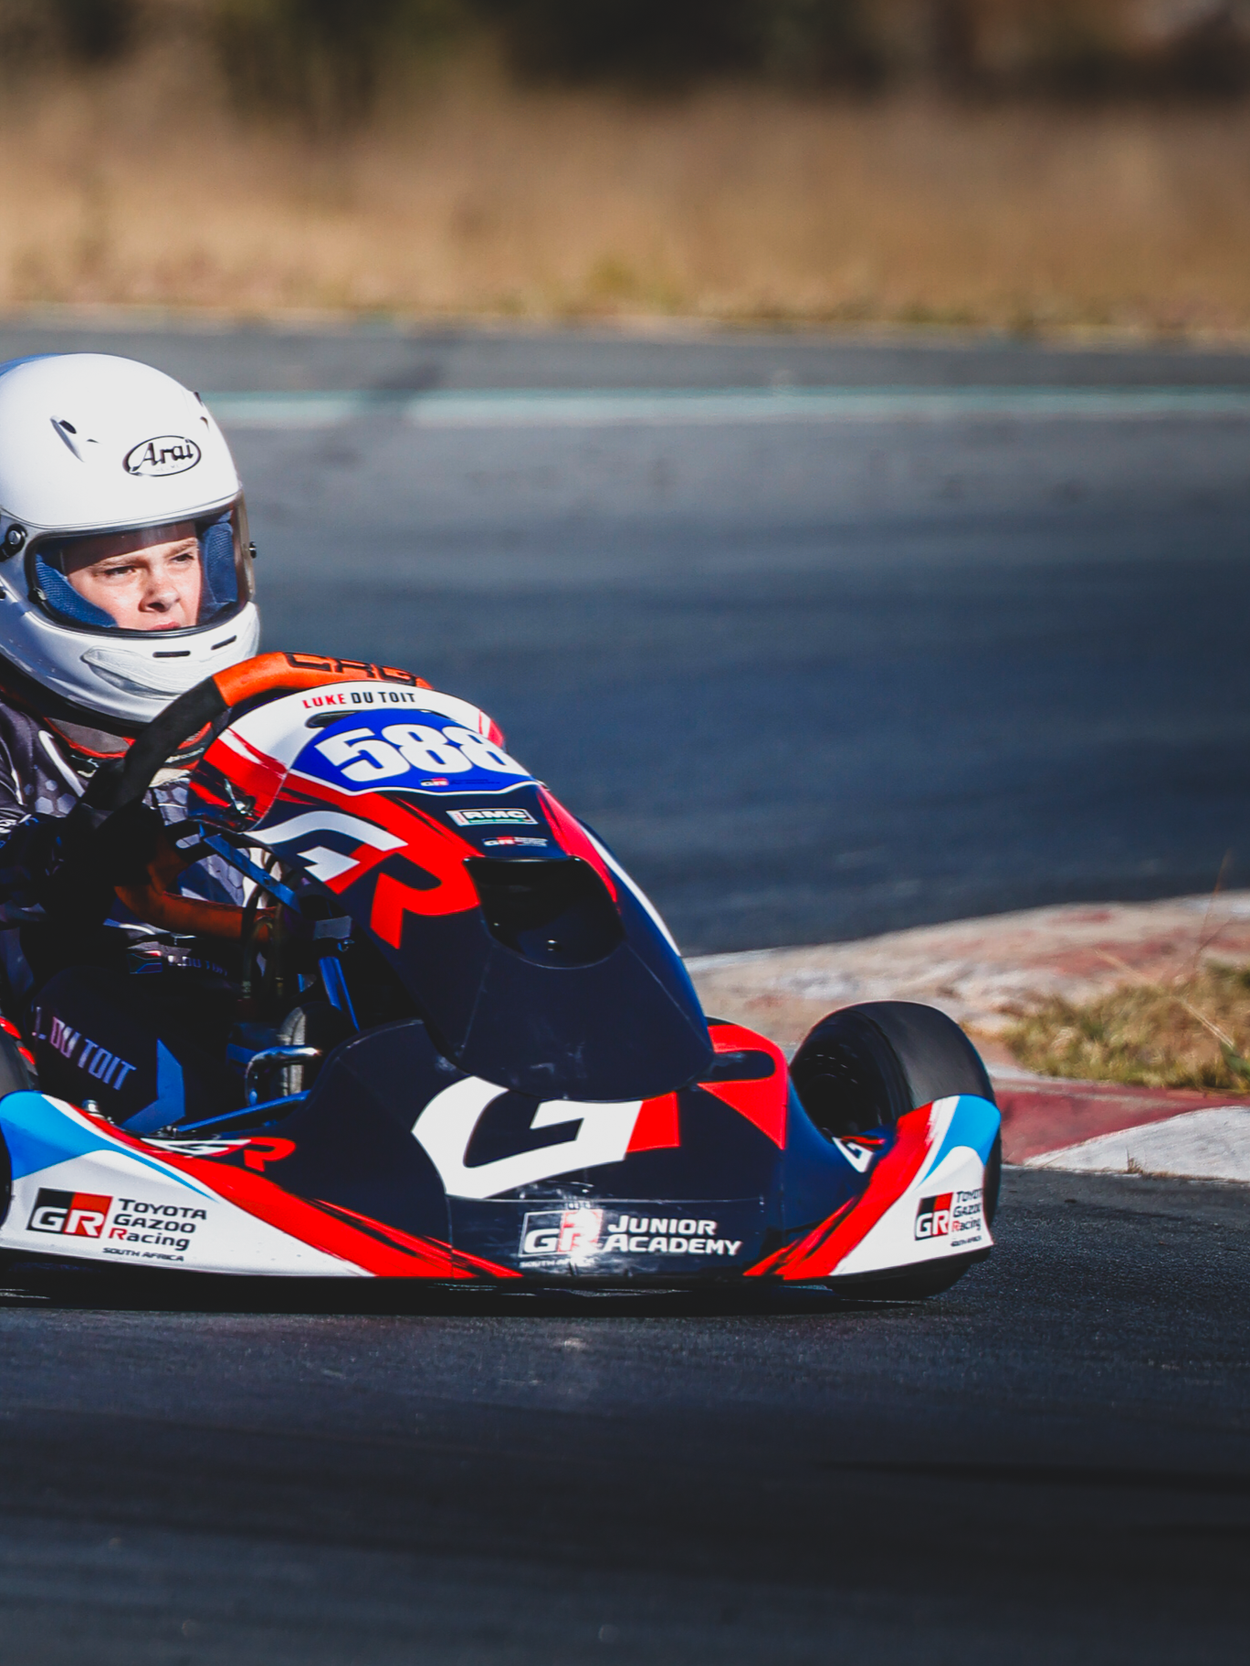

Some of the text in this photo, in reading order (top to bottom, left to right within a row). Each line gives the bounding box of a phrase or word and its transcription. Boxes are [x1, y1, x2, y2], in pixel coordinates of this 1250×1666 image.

[132, 438, 194, 472] Arai
[302, 691, 416, 709] LUKE DU TOIT
[314, 723, 531, 782] 588
[462, 810, 527, 820] RMC
[50, 1016, 81, 1058] DU
[77, 1038, 137, 1090] TOIT
[117, 1198, 207, 1220] TOYOTA
[31, 1206, 105, 1237] GR
[113, 1213, 197, 1234] GAZOO
[607, 1215, 717, 1236] JUNIOR
[915, 1210, 949, 1239] GR
[108, 1227, 191, 1251] Racing
[602, 1233, 742, 1256] ACADEMY
[102, 1247, 185, 1262] SOUTH AFRICA
